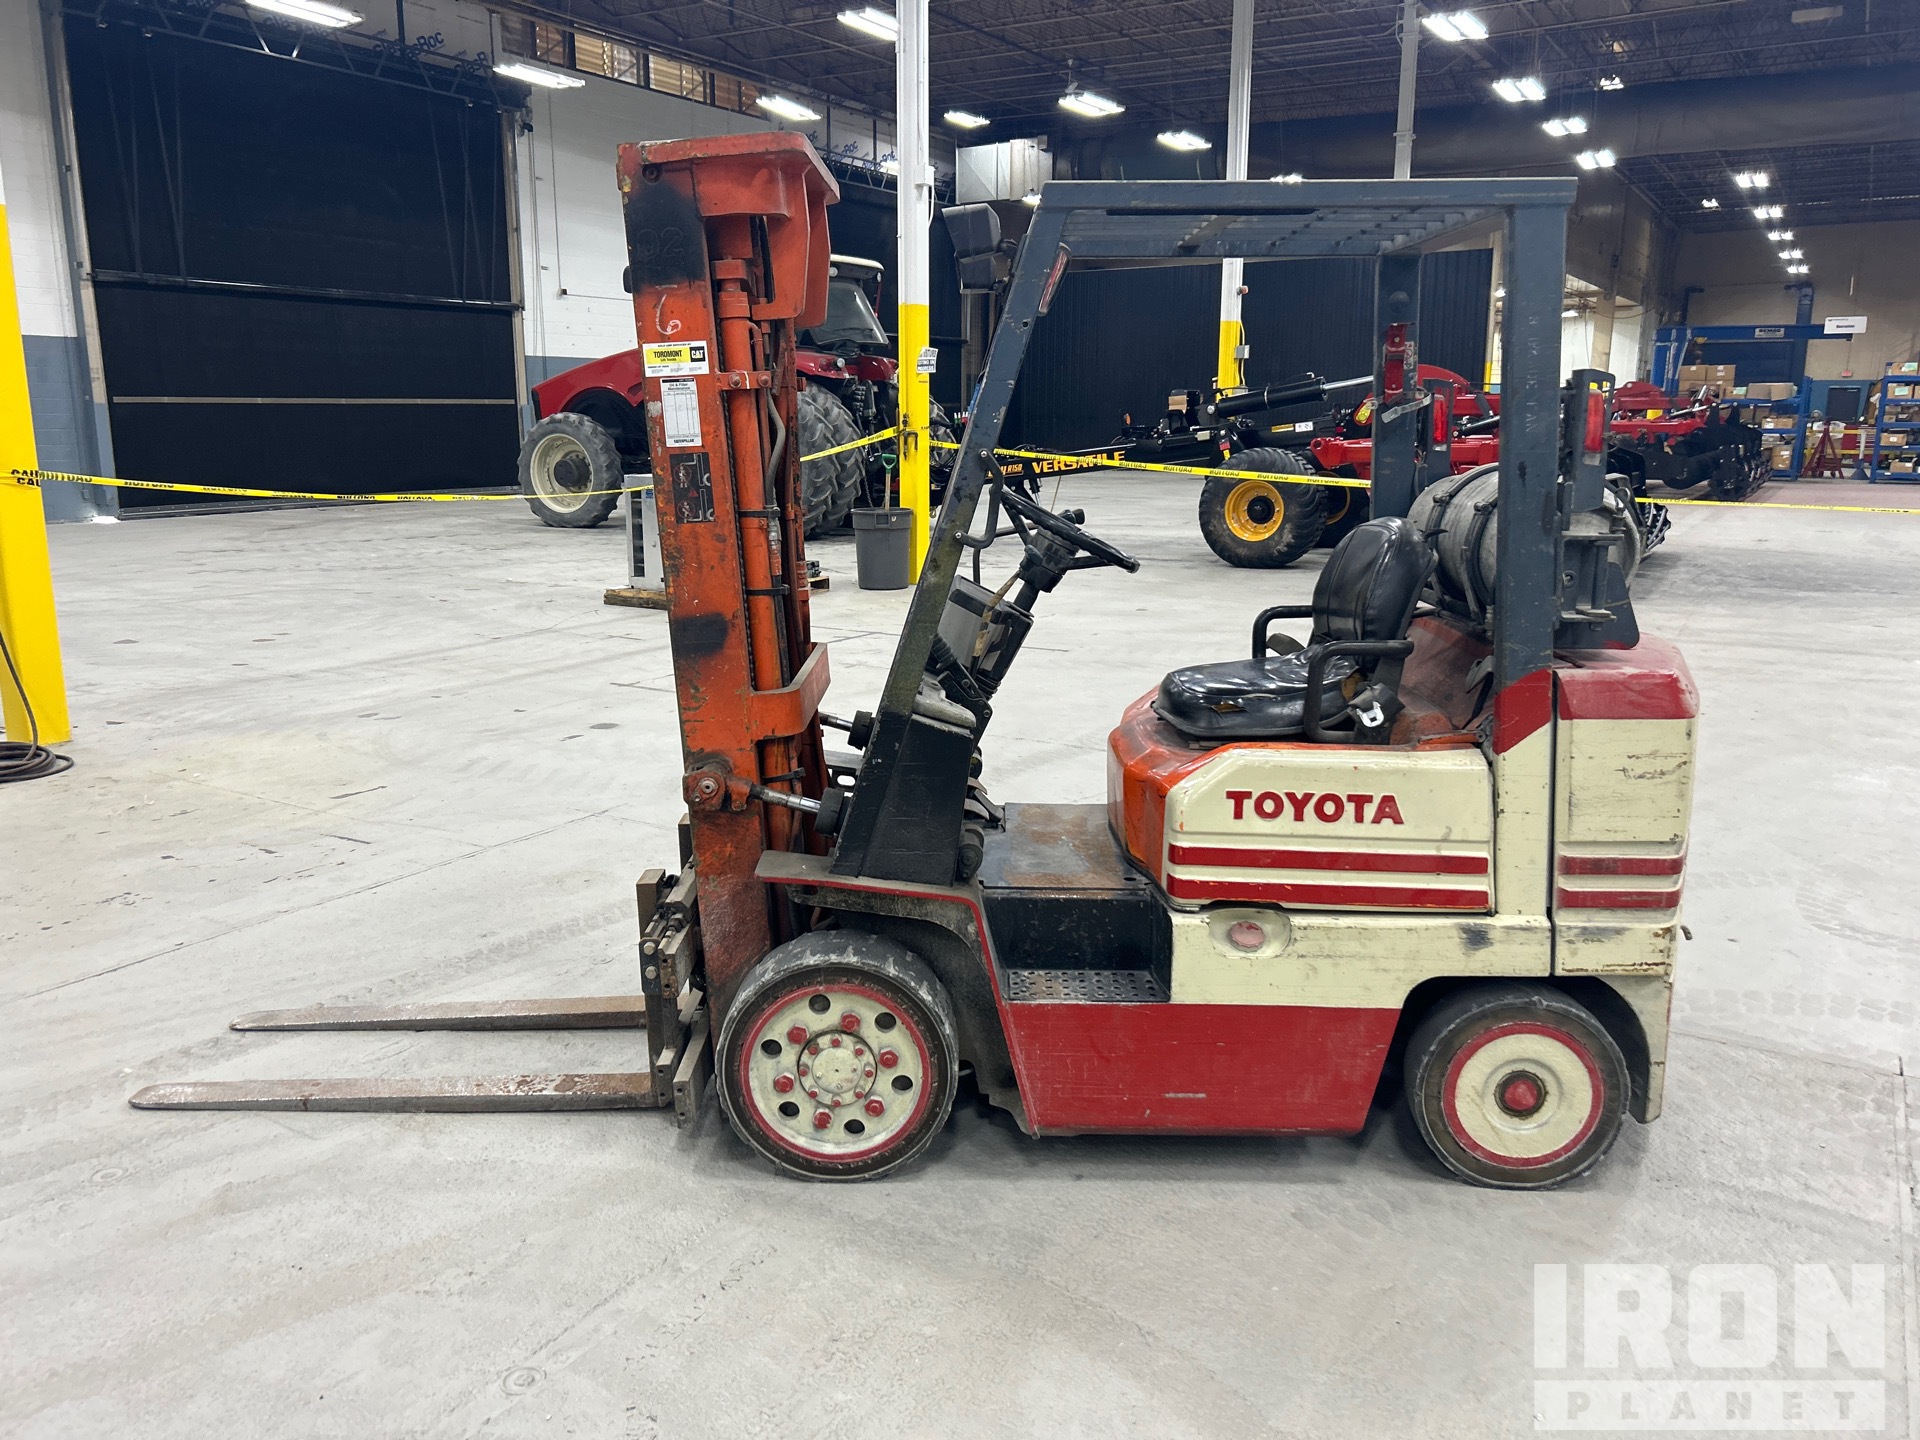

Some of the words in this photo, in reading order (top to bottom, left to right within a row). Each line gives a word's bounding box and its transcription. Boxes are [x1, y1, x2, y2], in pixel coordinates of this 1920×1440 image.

[653, 350, 682, 359] TOROMONT
[691, 350, 704, 359] CAT
[1032, 450, 1126, 475] VERSATILE
[1226, 790, 1404, 825] TOYOTA
